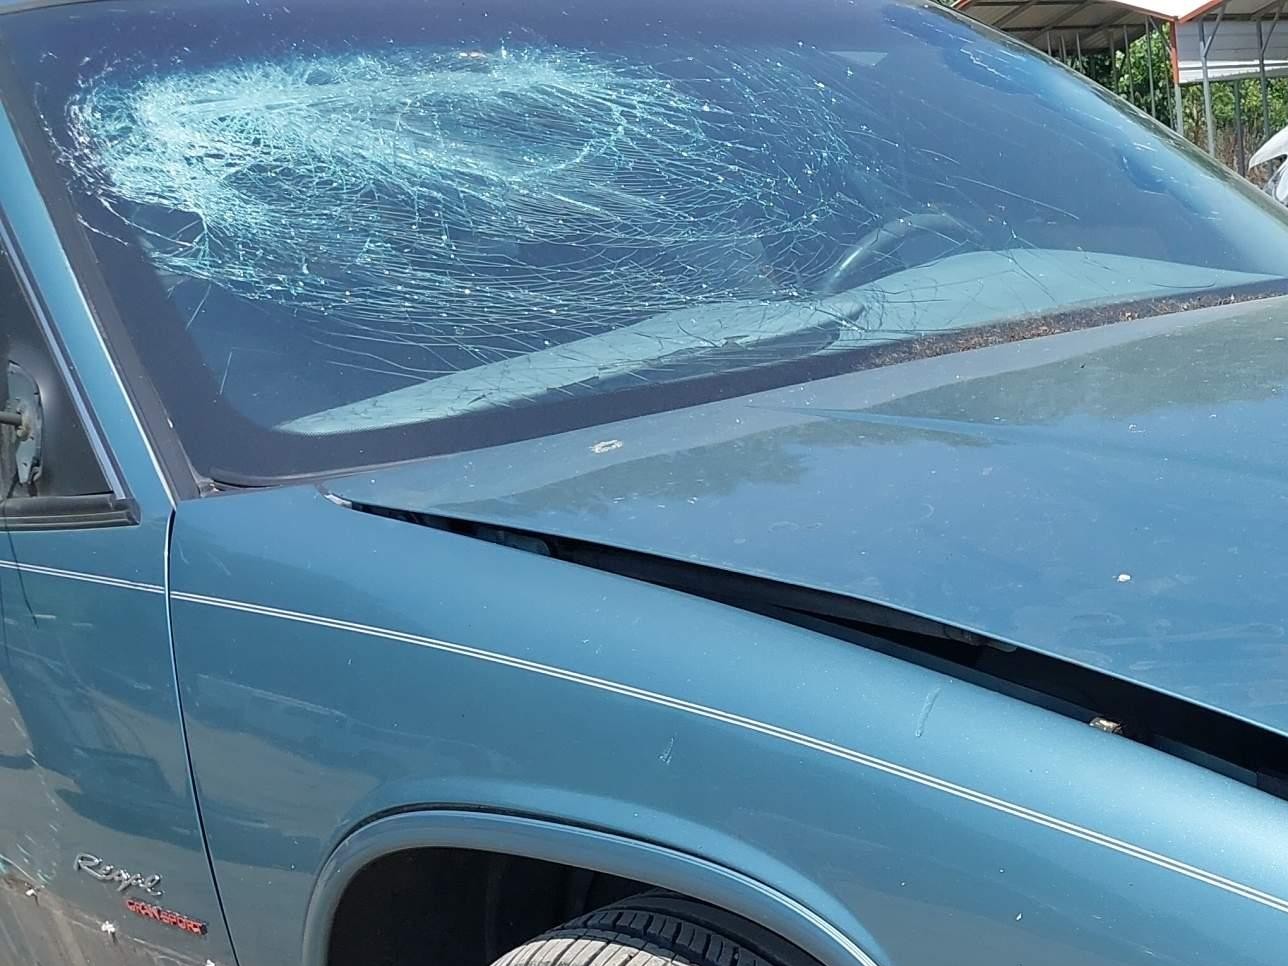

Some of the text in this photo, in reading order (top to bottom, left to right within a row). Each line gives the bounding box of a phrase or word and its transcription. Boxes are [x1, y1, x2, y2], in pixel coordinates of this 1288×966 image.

[73, 852, 165, 895] Regal
[126, 899, 206, 936] GRAN SPORT
